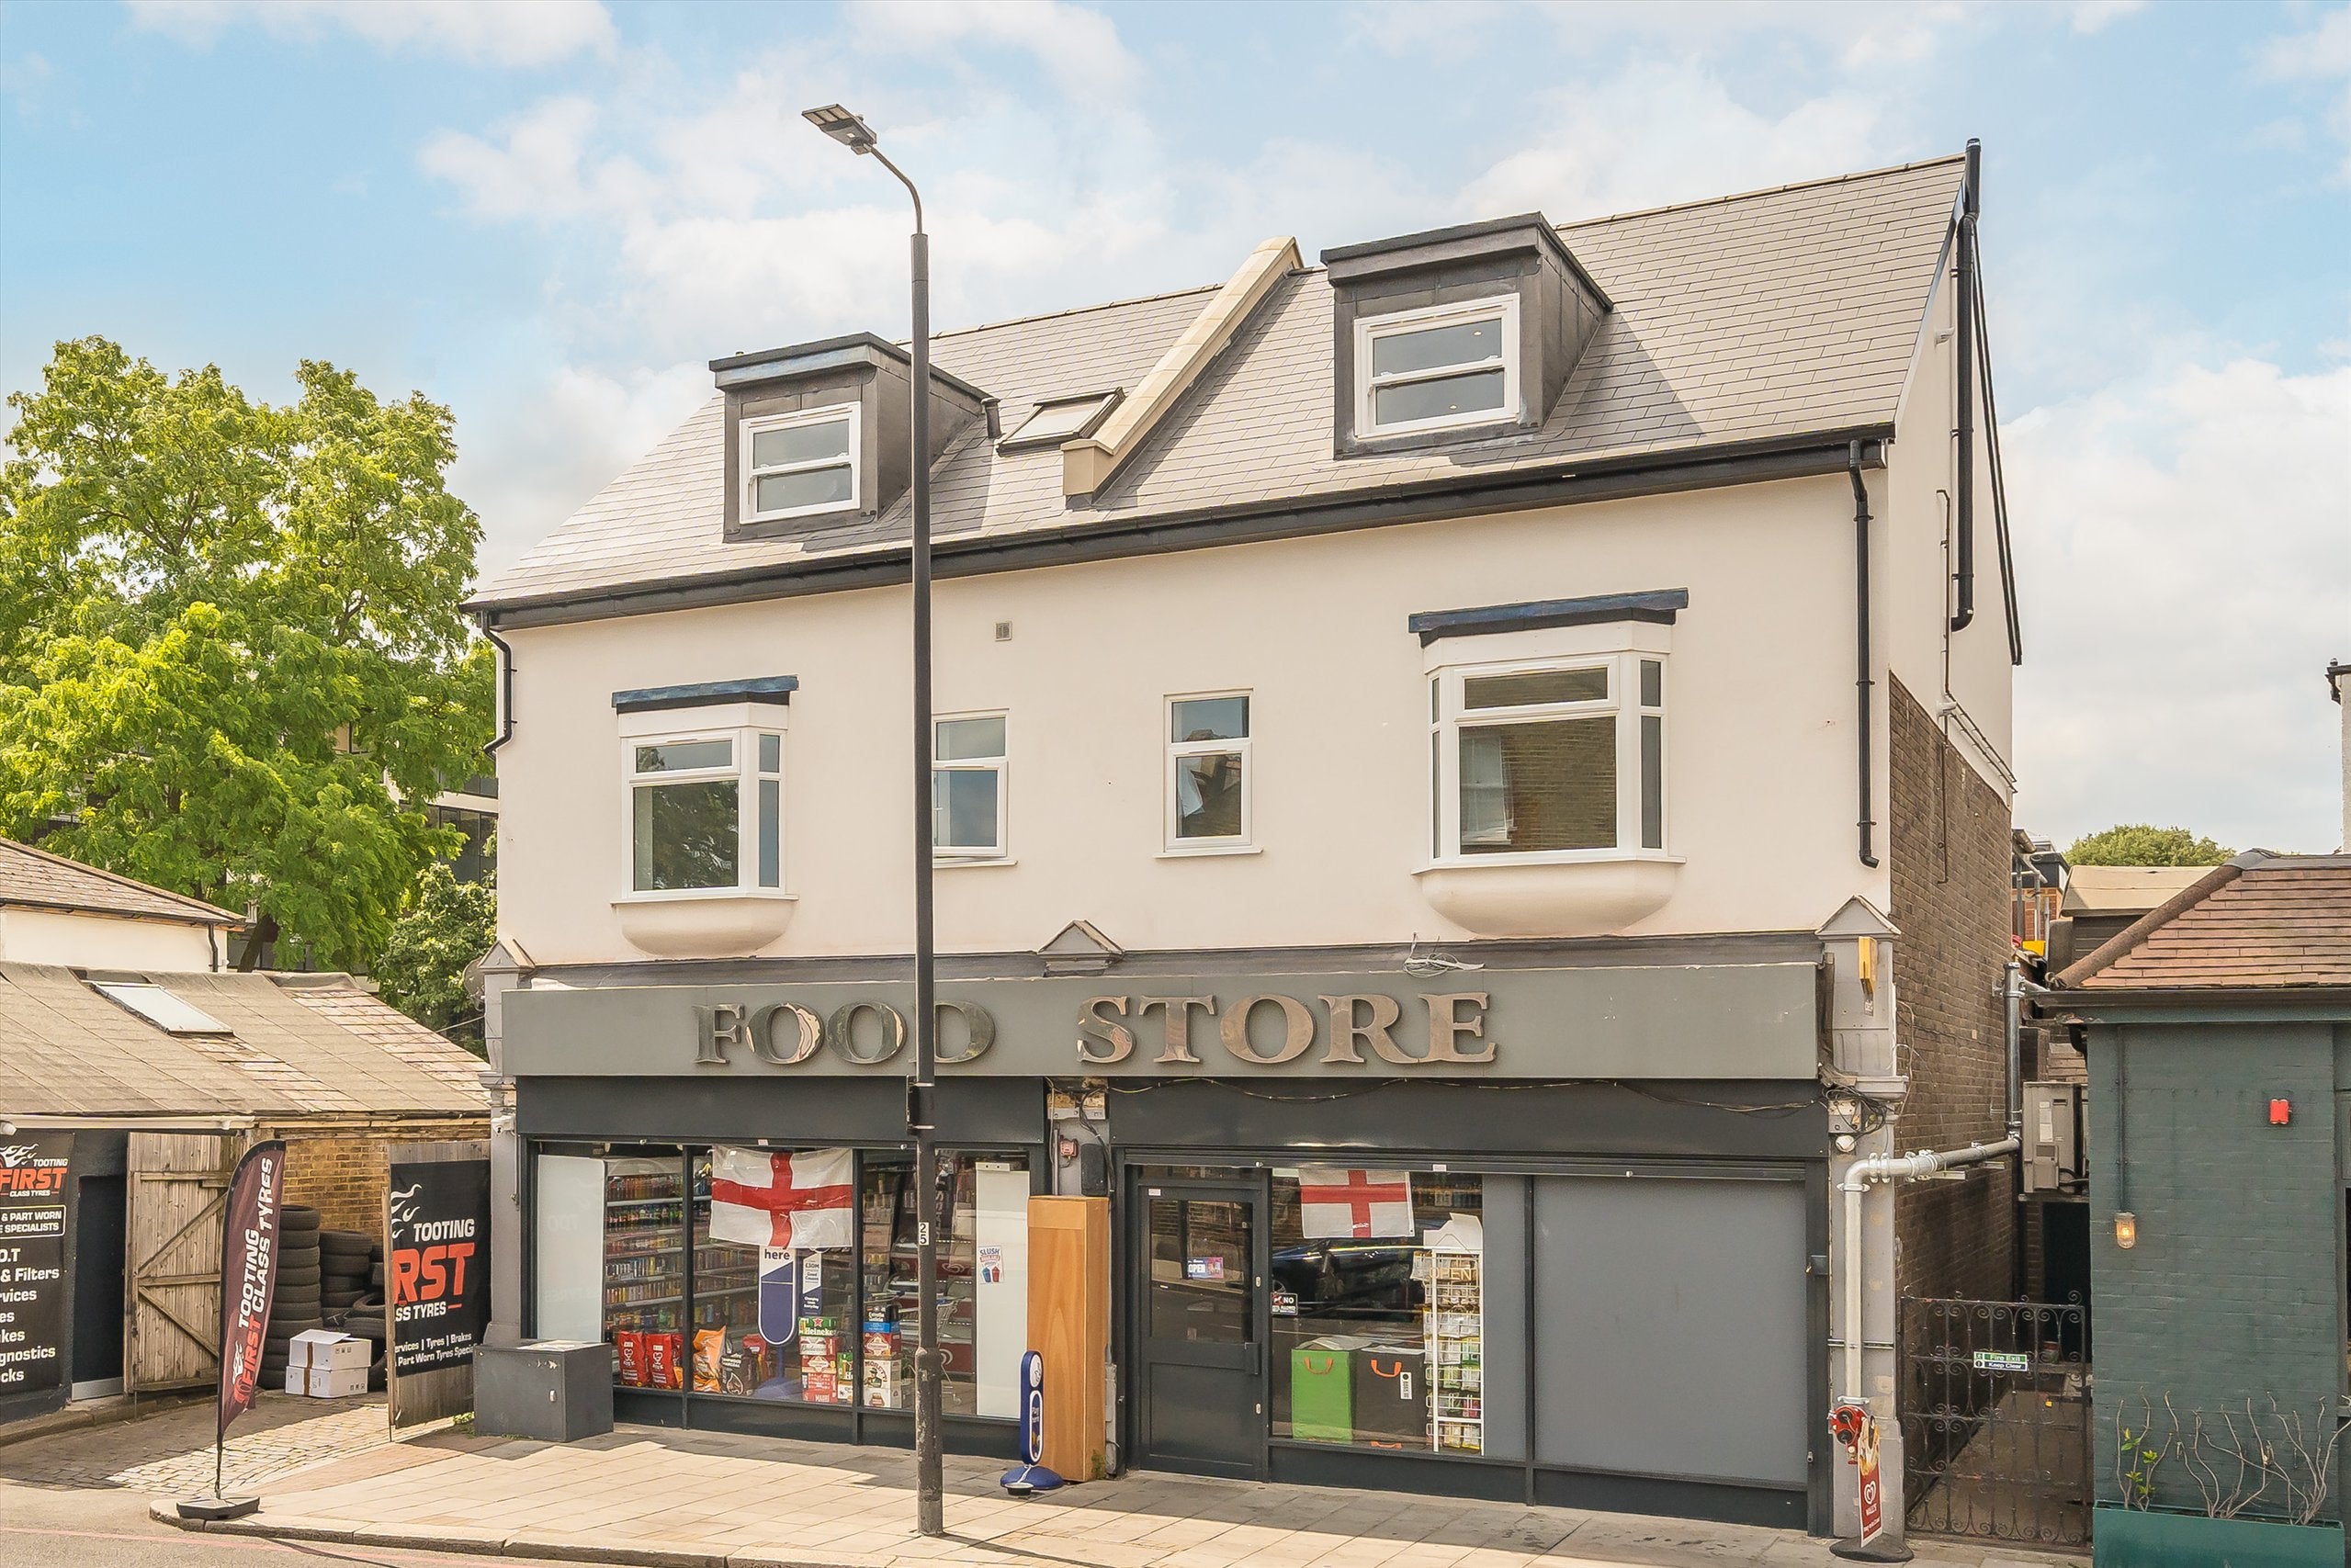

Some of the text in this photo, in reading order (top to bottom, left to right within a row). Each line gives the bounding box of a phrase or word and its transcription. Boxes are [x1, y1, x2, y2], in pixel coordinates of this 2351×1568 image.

[691, 991, 1498, 1066] FOOD STORE
[33, 1158, 69, 1168] TOOTING
[0, 1168, 67, 1191] FIRST
[2, 1211, 62, 1222] & PART WORN
[5, 1223, 59, 1233] SPECIALISTS
[413, 1219, 475, 1242] TOOTING
[920, 1224, 926, 1244] 25
[764, 1249, 790, 1259] here
[1, 1269, 60, 1282] & Filters
[242, 1157, 273, 1386] FIRST CLASS TYRES
[392, 1243, 475, 1304] RST
[1188, 1264, 1205, 1272] OPEN
[238, 1228, 259, 1328] TOOTING
[413, 1301, 446, 1319] TYRES
[0, 1329, 26, 1343] kes
[426, 1337, 445, 1349] Tyres
[450, 1333, 472, 1344] Brakes
[0, 1346, 56, 1366] gnostics
[398, 1356, 414, 1367] Part
[415, 1353, 435, 1364] Worn
[436, 1349, 454, 1360] Tyres
